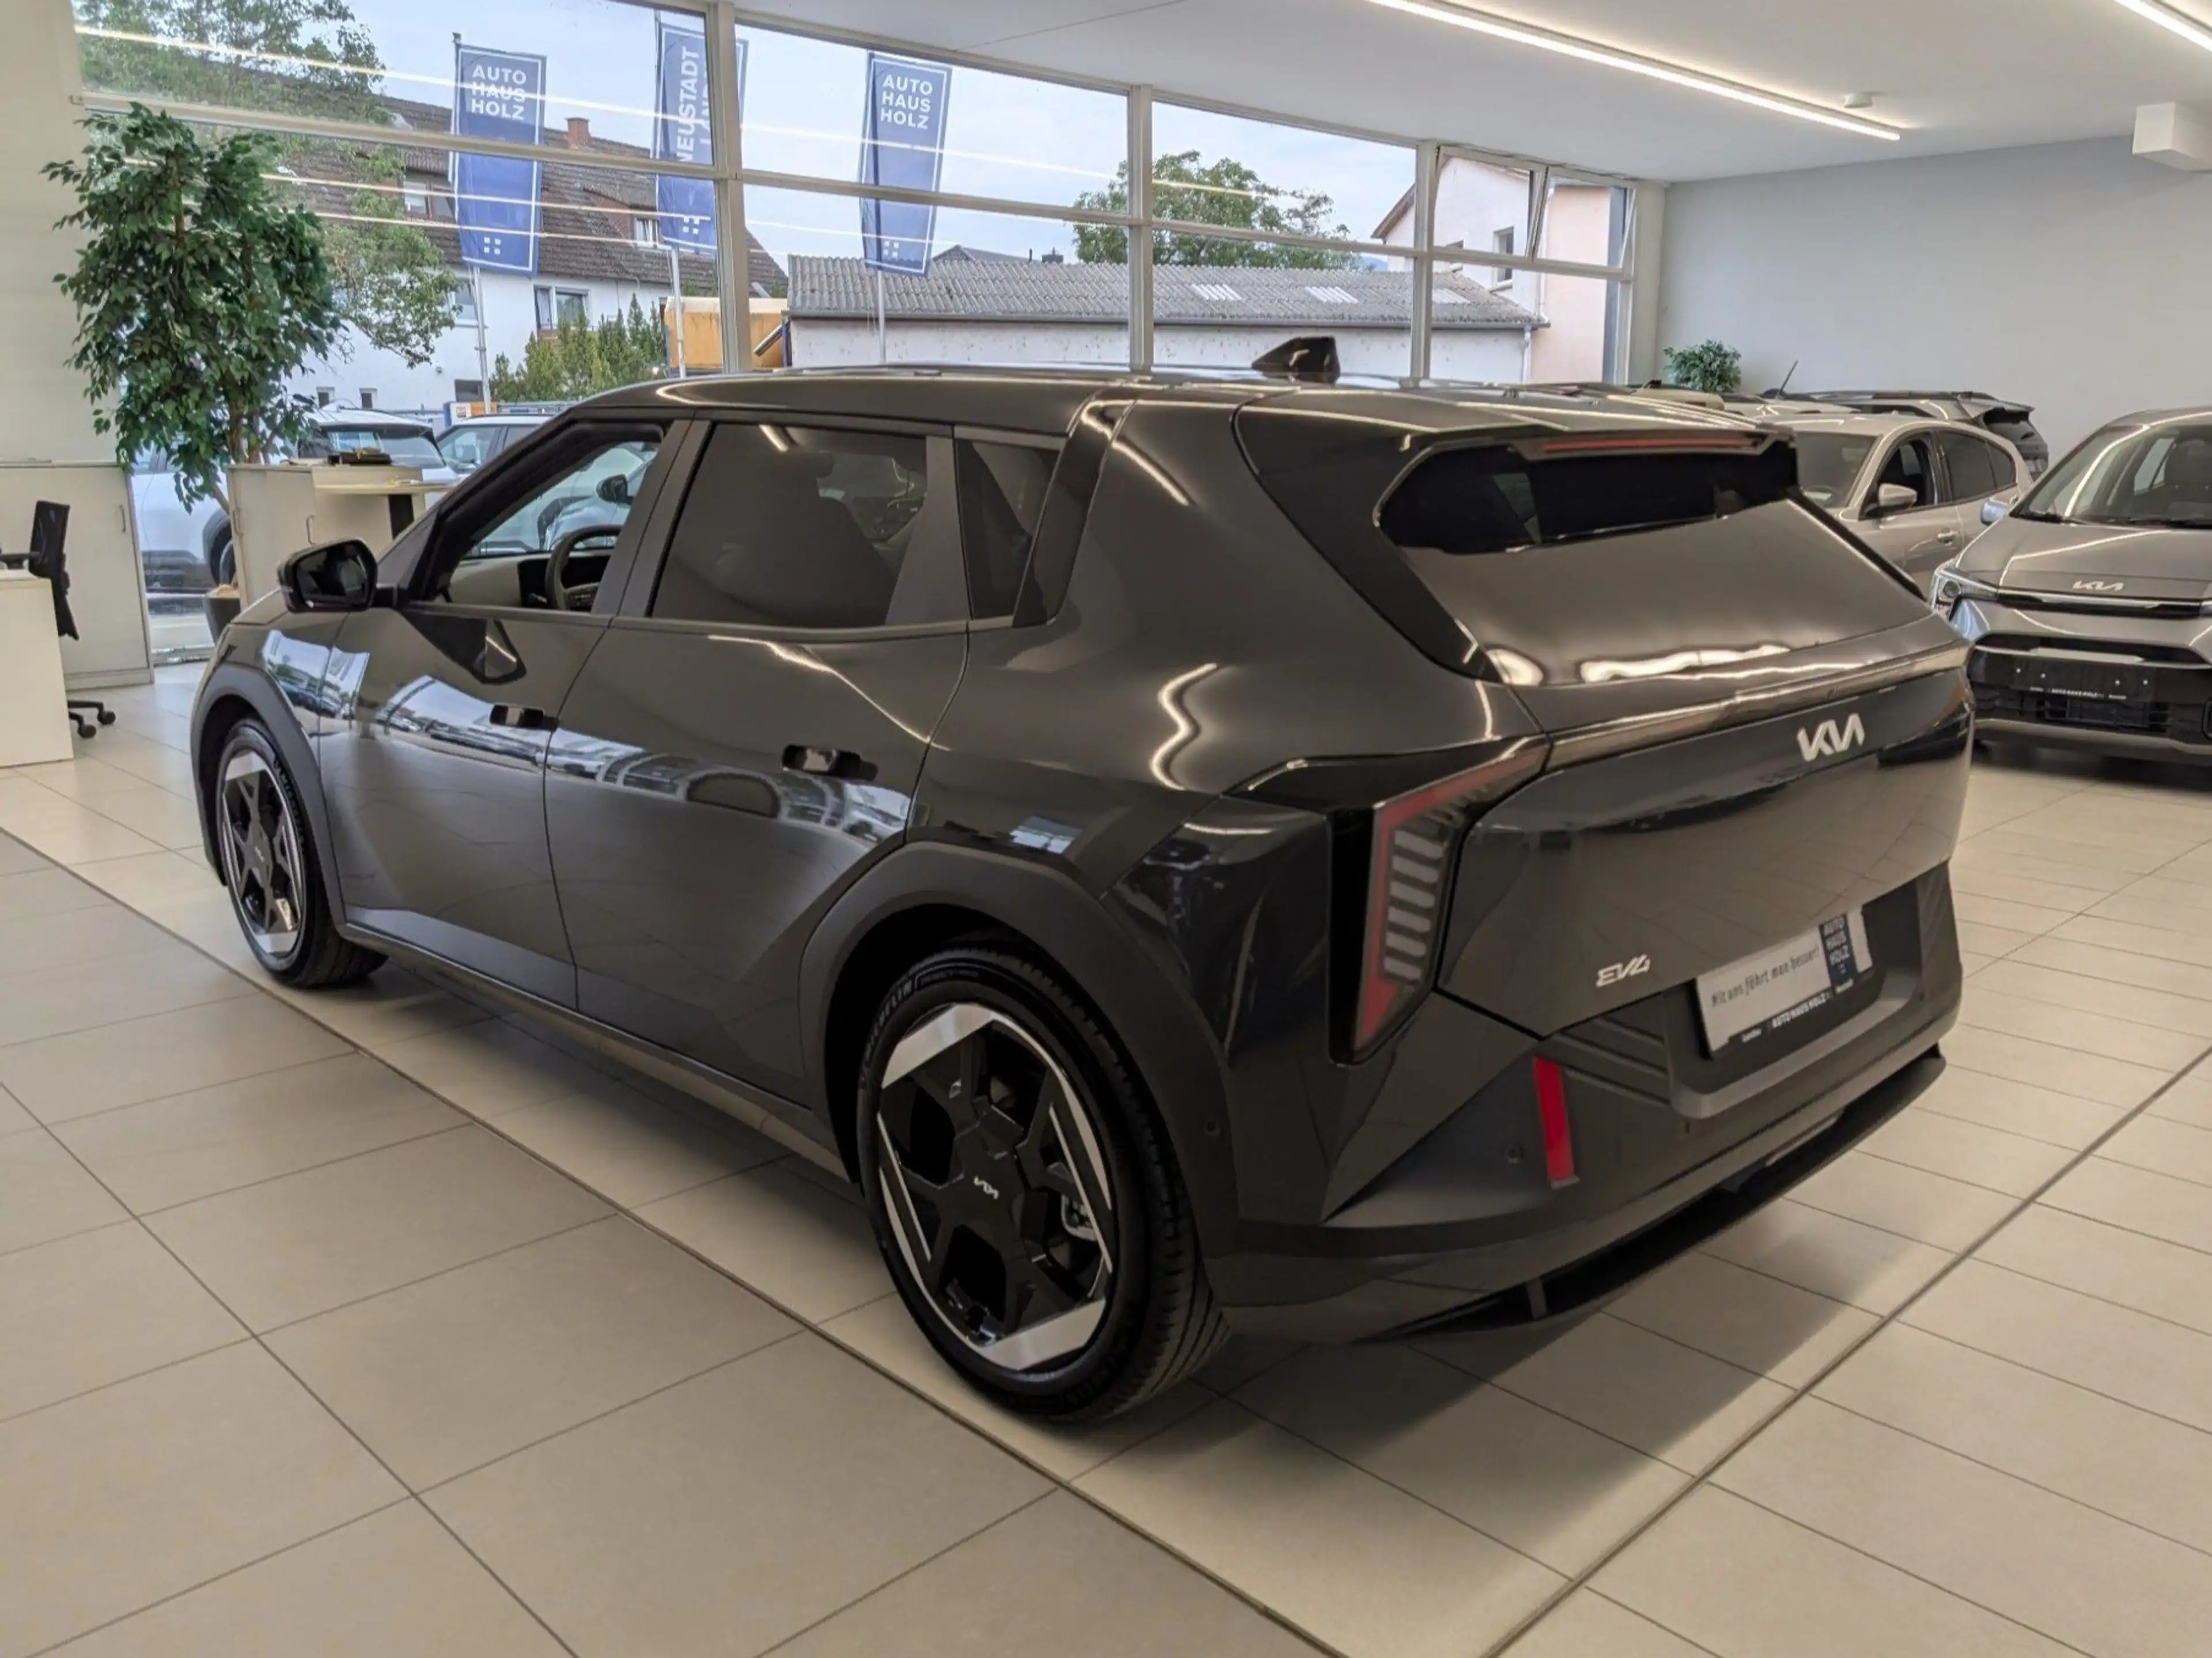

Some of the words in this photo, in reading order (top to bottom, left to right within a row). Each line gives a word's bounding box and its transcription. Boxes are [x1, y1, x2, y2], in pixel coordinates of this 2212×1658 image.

[472, 65, 527, 85] AUTO
[883, 74, 933, 96] AUTO
[472, 82, 525, 103] HAUS
[882, 90, 931, 112] HAUS
[471, 98, 524, 120] HOLZ
[880, 108, 929, 129] HOLZ
[2072, 580, 2124, 592] KIA
[1796, 712, 1866, 762] KIA
[1596, 955, 1651, 987] EV4
